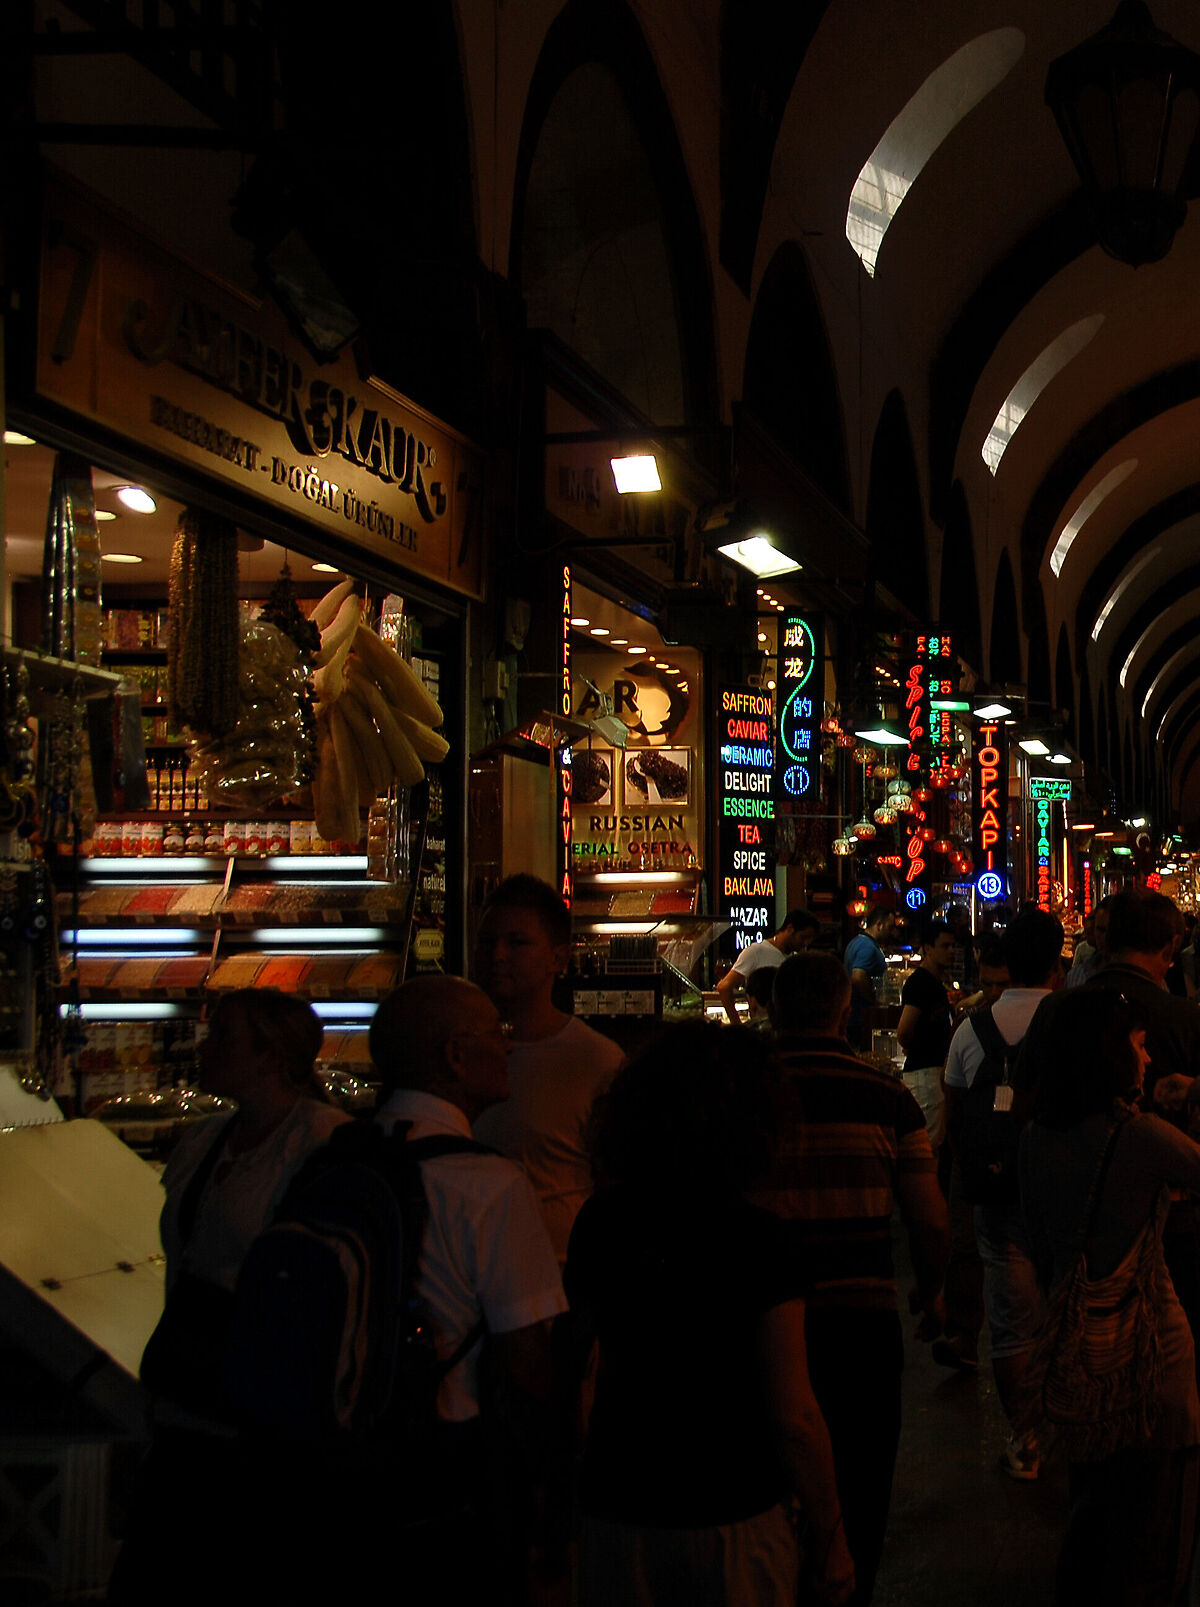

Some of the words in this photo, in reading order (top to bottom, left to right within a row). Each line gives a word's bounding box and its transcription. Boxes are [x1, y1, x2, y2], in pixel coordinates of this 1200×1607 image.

[722, 692, 773, 716] SAFFRON
[727, 719, 768, 741] CAVIAR
[724, 744, 773, 768] CERAMIC
[724, 771, 772, 793] DELIGHT
[723, 797, 774, 820] ESSENCE
[978, 726, 1001, 869] TOPKAPI
[589, 815, 684, 831] RUSSIAN
[738, 823, 761, 845] TEA
[1037, 799, 1050, 856] CAVIAR
[628, 842, 693, 855] OSETRA
[733, 850, 767, 871] SPICE
[724, 876, 774, 897] BAKLAVA
[730, 906, 768, 927] NAZAR
